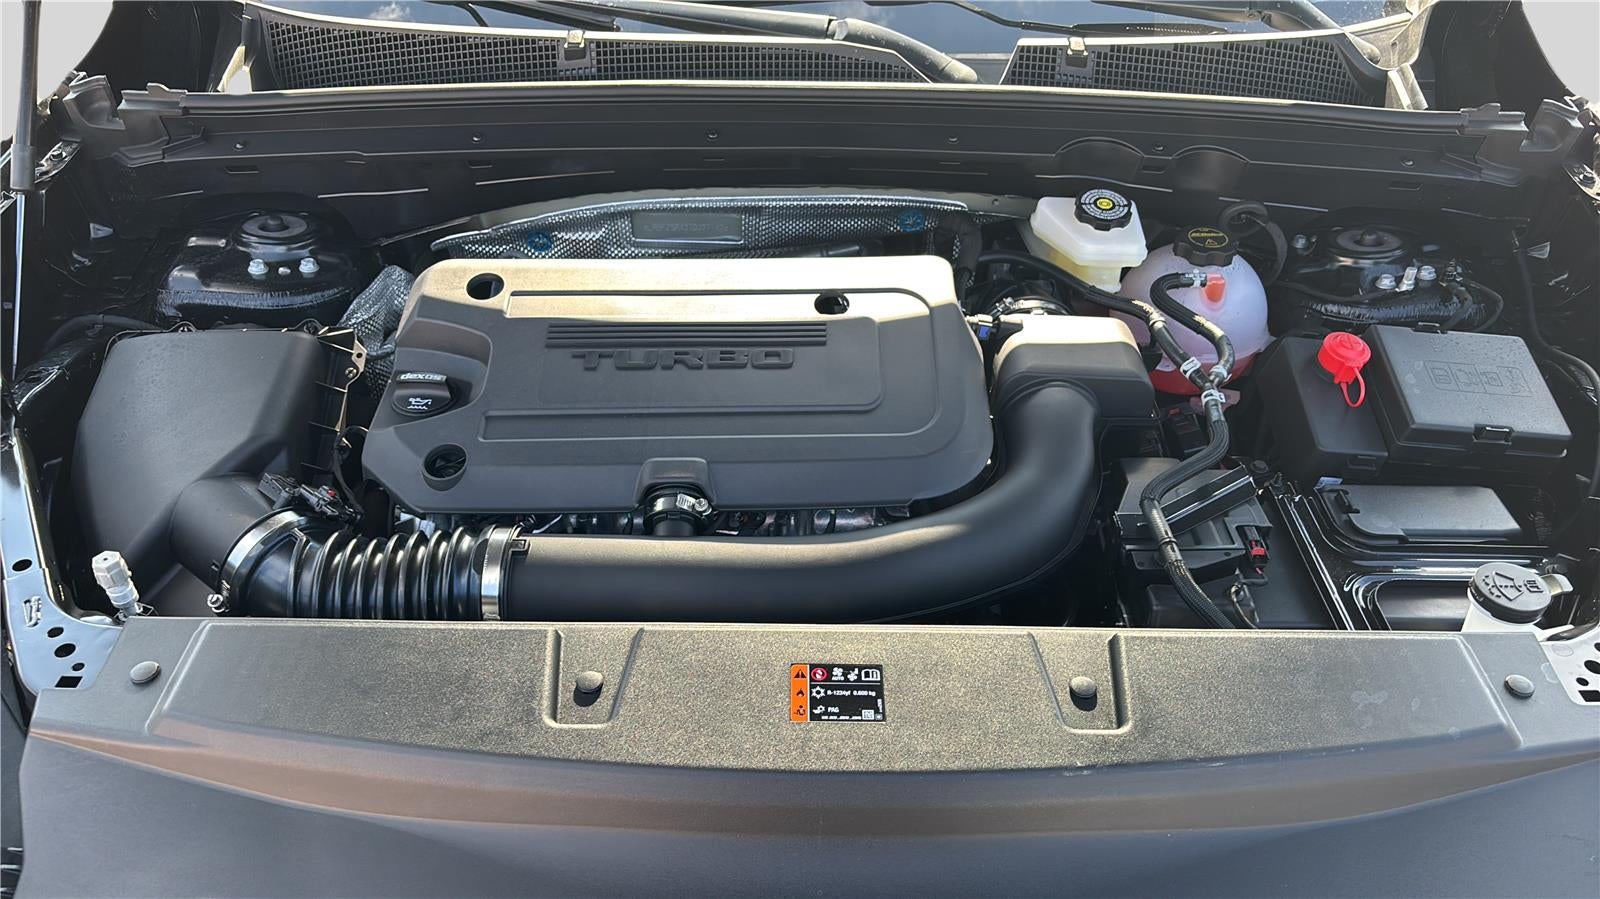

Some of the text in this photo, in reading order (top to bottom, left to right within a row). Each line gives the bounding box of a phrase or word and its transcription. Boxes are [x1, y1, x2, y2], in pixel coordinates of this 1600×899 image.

[571, 347, 795, 371] TURBO
[400, 372, 443, 381] dexos
[826, 689, 851, 697] R-1234yf
